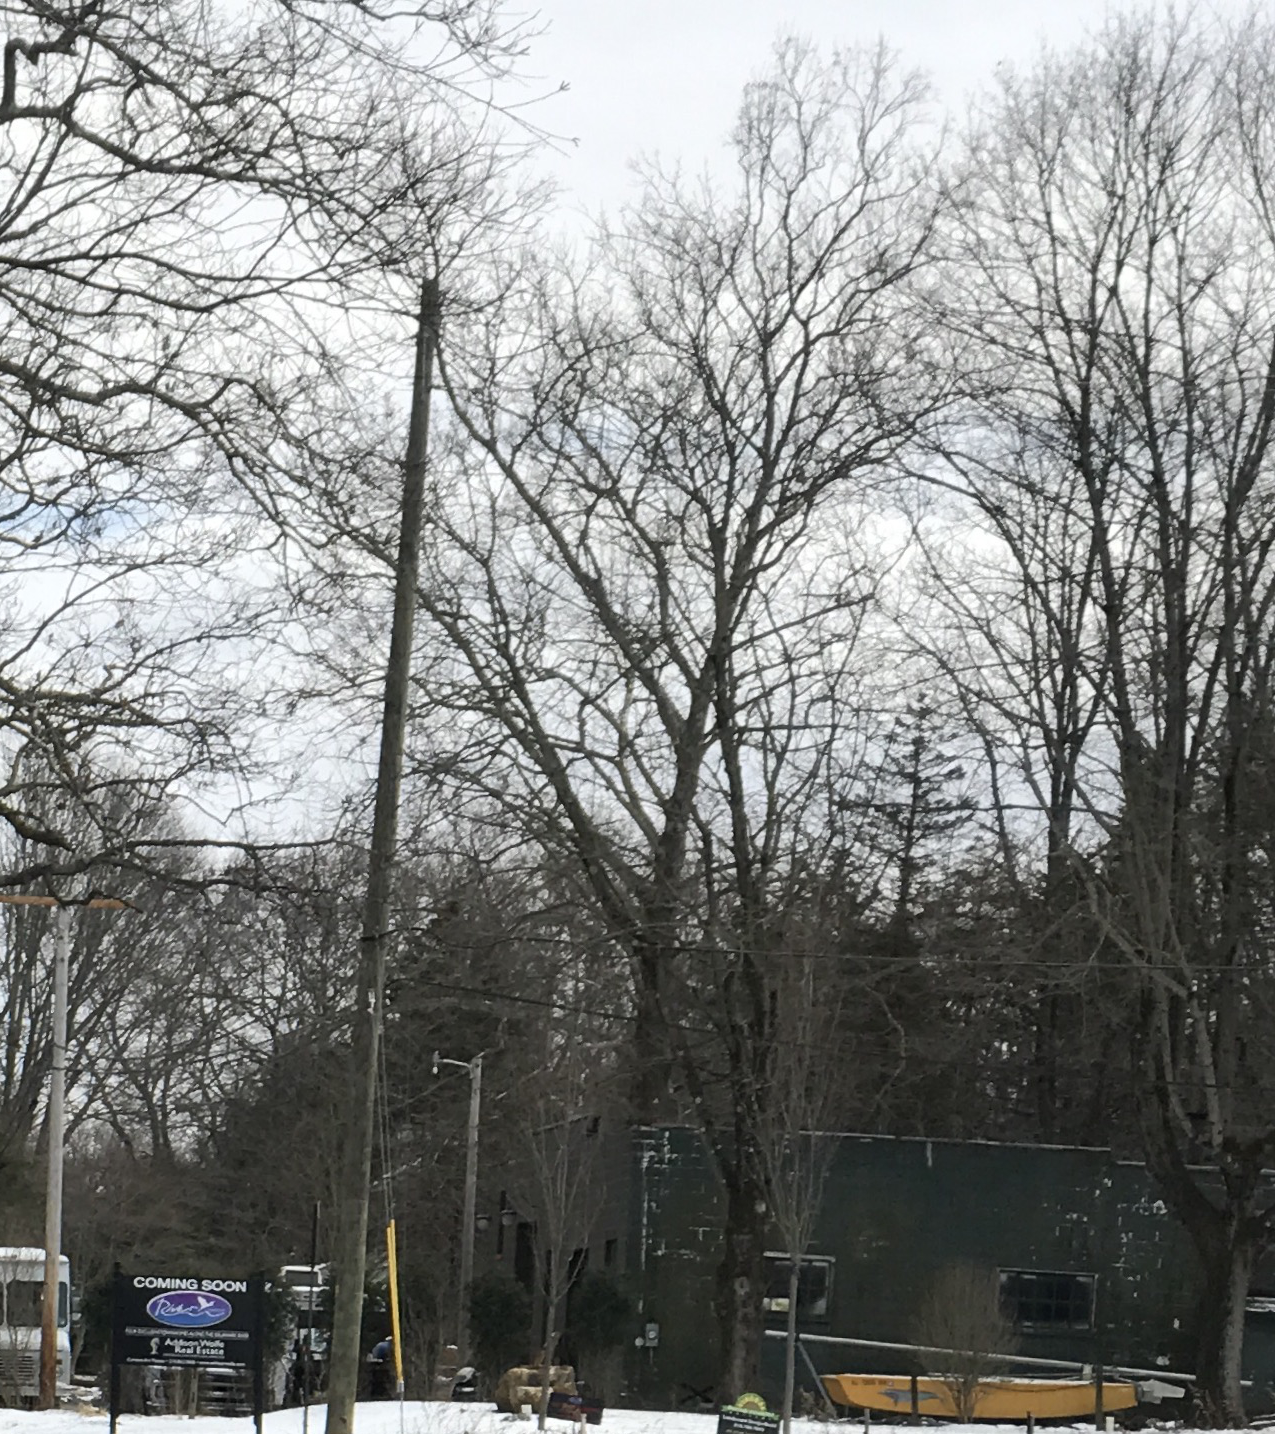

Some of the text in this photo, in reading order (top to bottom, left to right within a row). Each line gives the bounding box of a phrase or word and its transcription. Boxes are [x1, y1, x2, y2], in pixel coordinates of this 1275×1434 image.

[133, 1276, 247, 1292] COMING SOON
[174, 1345, 225, 1355] Real Estate
